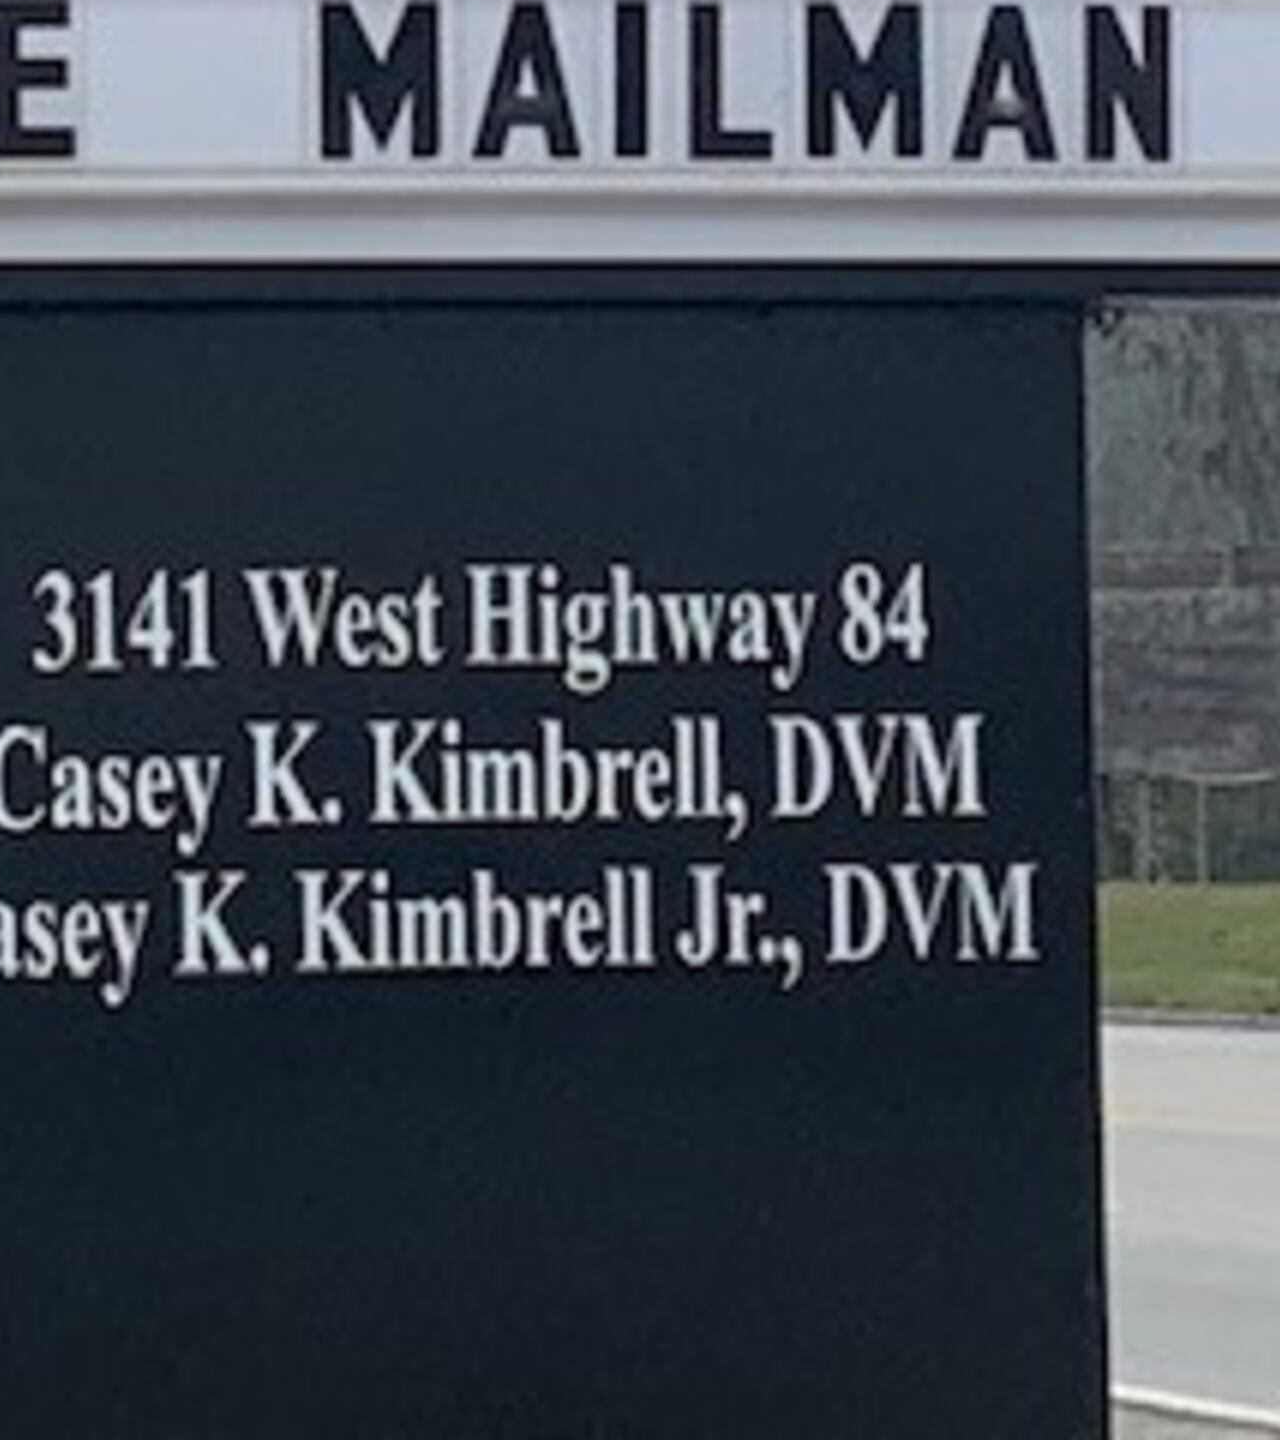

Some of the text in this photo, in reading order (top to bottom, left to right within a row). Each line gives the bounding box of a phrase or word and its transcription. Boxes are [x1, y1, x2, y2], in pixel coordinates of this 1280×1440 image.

[33, 563, 928, 691] 3141 West Highway 84
[249, 721, 341, 826] K.
[370, 718, 746, 839] Kimbrell,
[771, 714, 983, 817] DVM
[177, 871, 269, 974] K.
[297, 867, 653, 972] Kimbrell
[677, 866, 801, 989] Jr.,
[826, 863, 1036, 962] DVM
